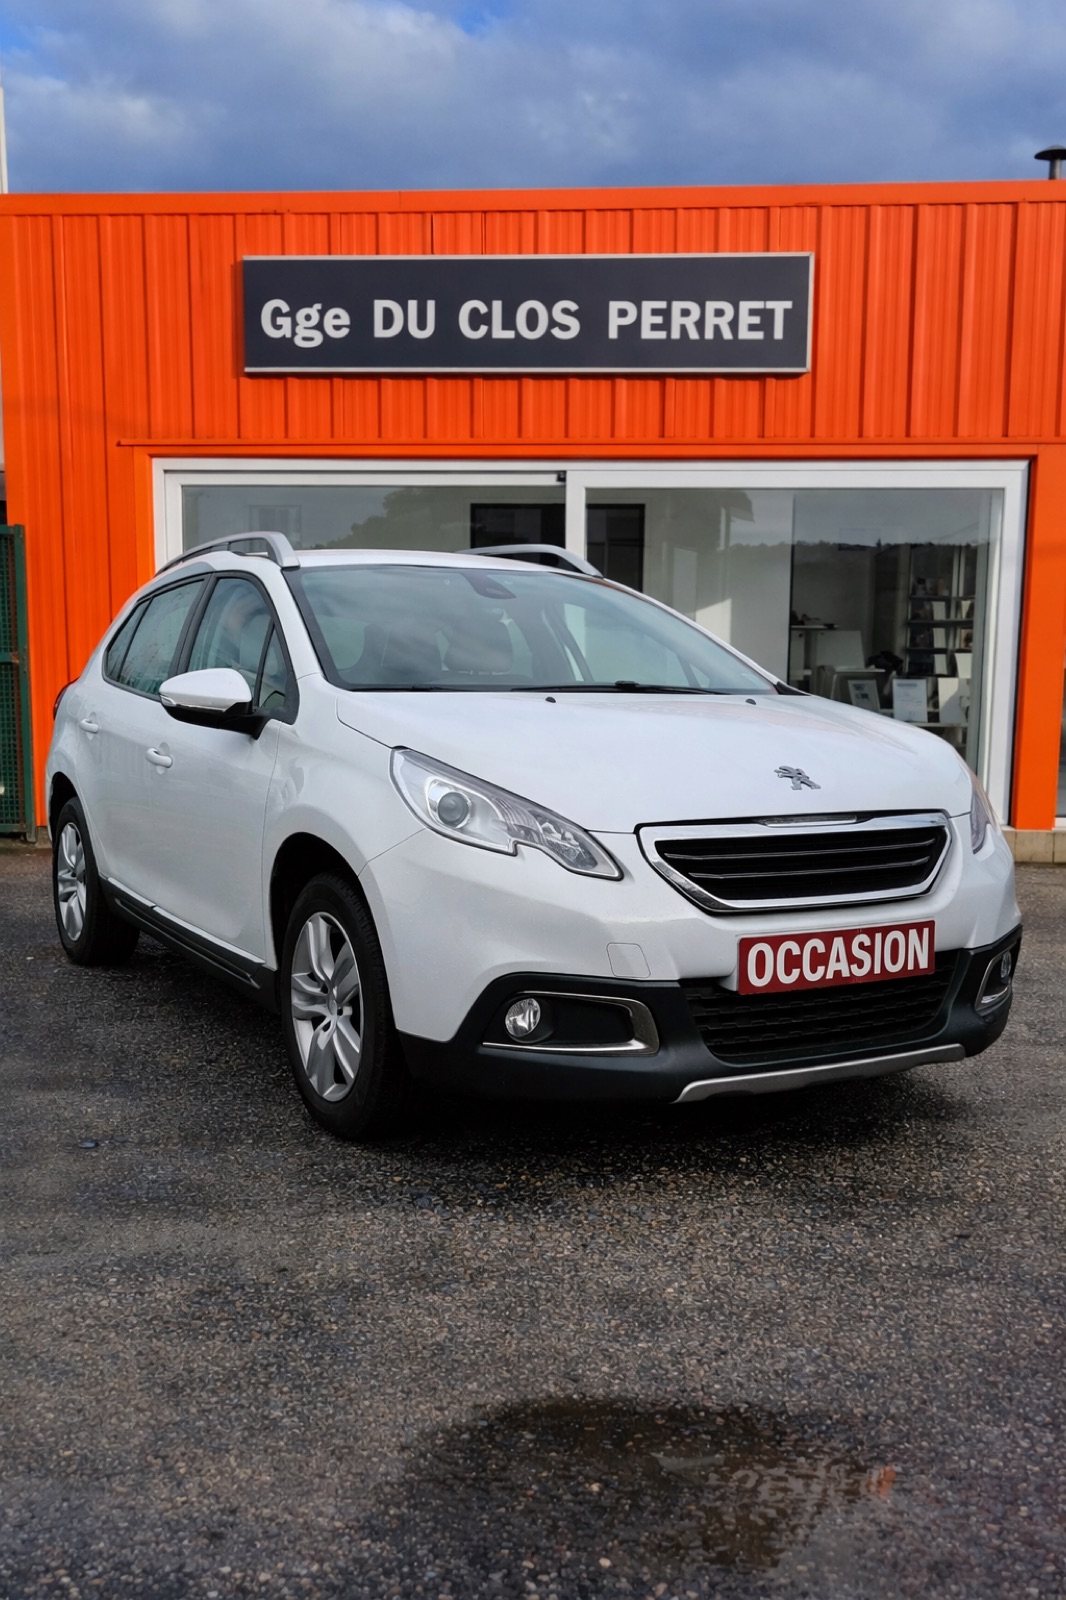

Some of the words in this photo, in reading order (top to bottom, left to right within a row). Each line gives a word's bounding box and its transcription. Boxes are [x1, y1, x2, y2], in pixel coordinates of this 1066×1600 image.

[260, 298, 351, 348] Gge
[373, 299, 436, 339] DU
[458, 299, 581, 340] CLOS
[608, 300, 793, 341] PERRET
[747, 927, 930, 987] OCCASION
